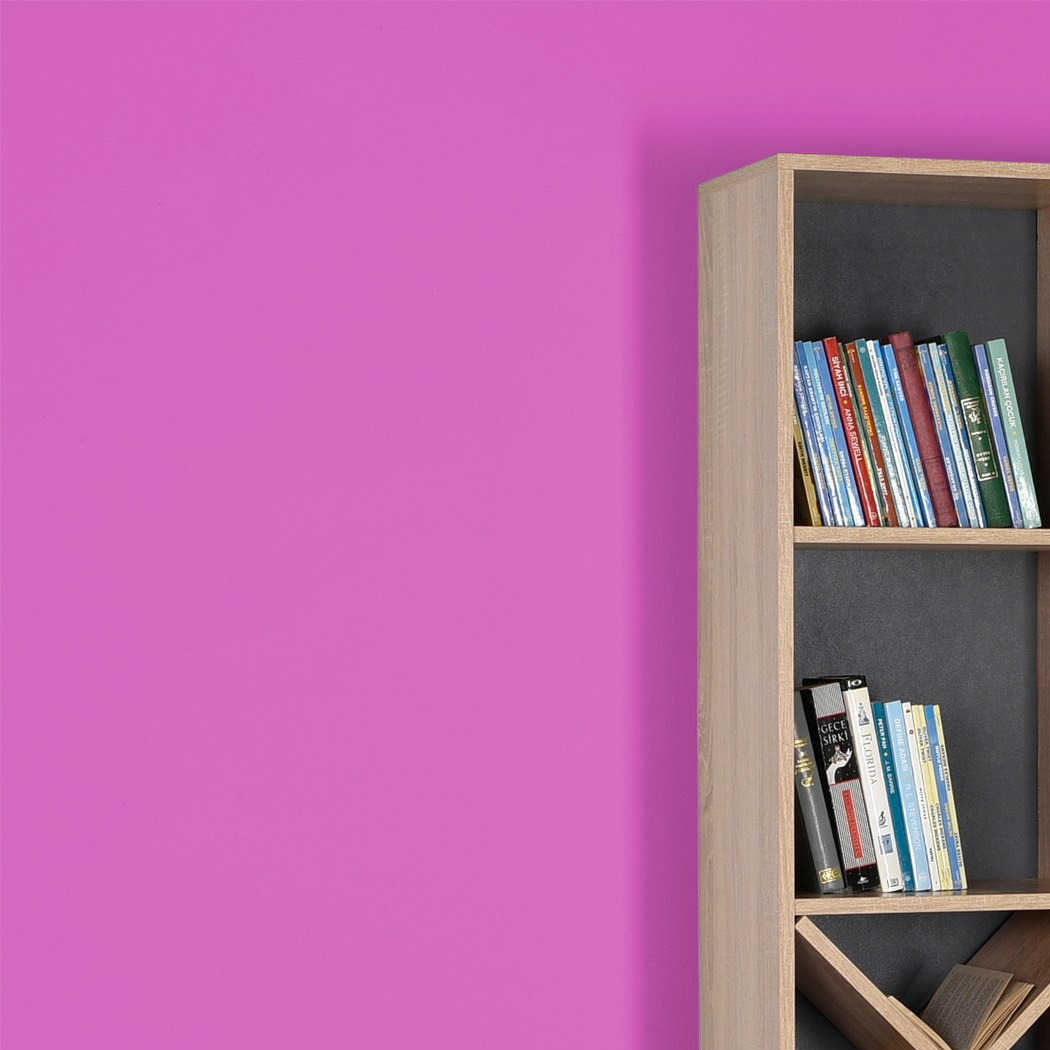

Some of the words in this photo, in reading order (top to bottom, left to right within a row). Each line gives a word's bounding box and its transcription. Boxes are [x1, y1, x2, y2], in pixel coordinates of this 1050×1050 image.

[994, 357, 1012, 400] KAÇIRILAN
[1002, 400, 1017, 428] ÇOCUK
[844, 408, 854, 430] ANNA
[849, 431, 862, 461] SEWELL
[820, 720, 847, 734] GECE
[822, 730, 848, 745] SİRKİ
[861, 733, 880, 785] FLORIDA
[943, 768, 951, 791] CHARLES
[907, 802, 922, 850] STEVENSON
[929, 805, 937, 828] CHARLES
